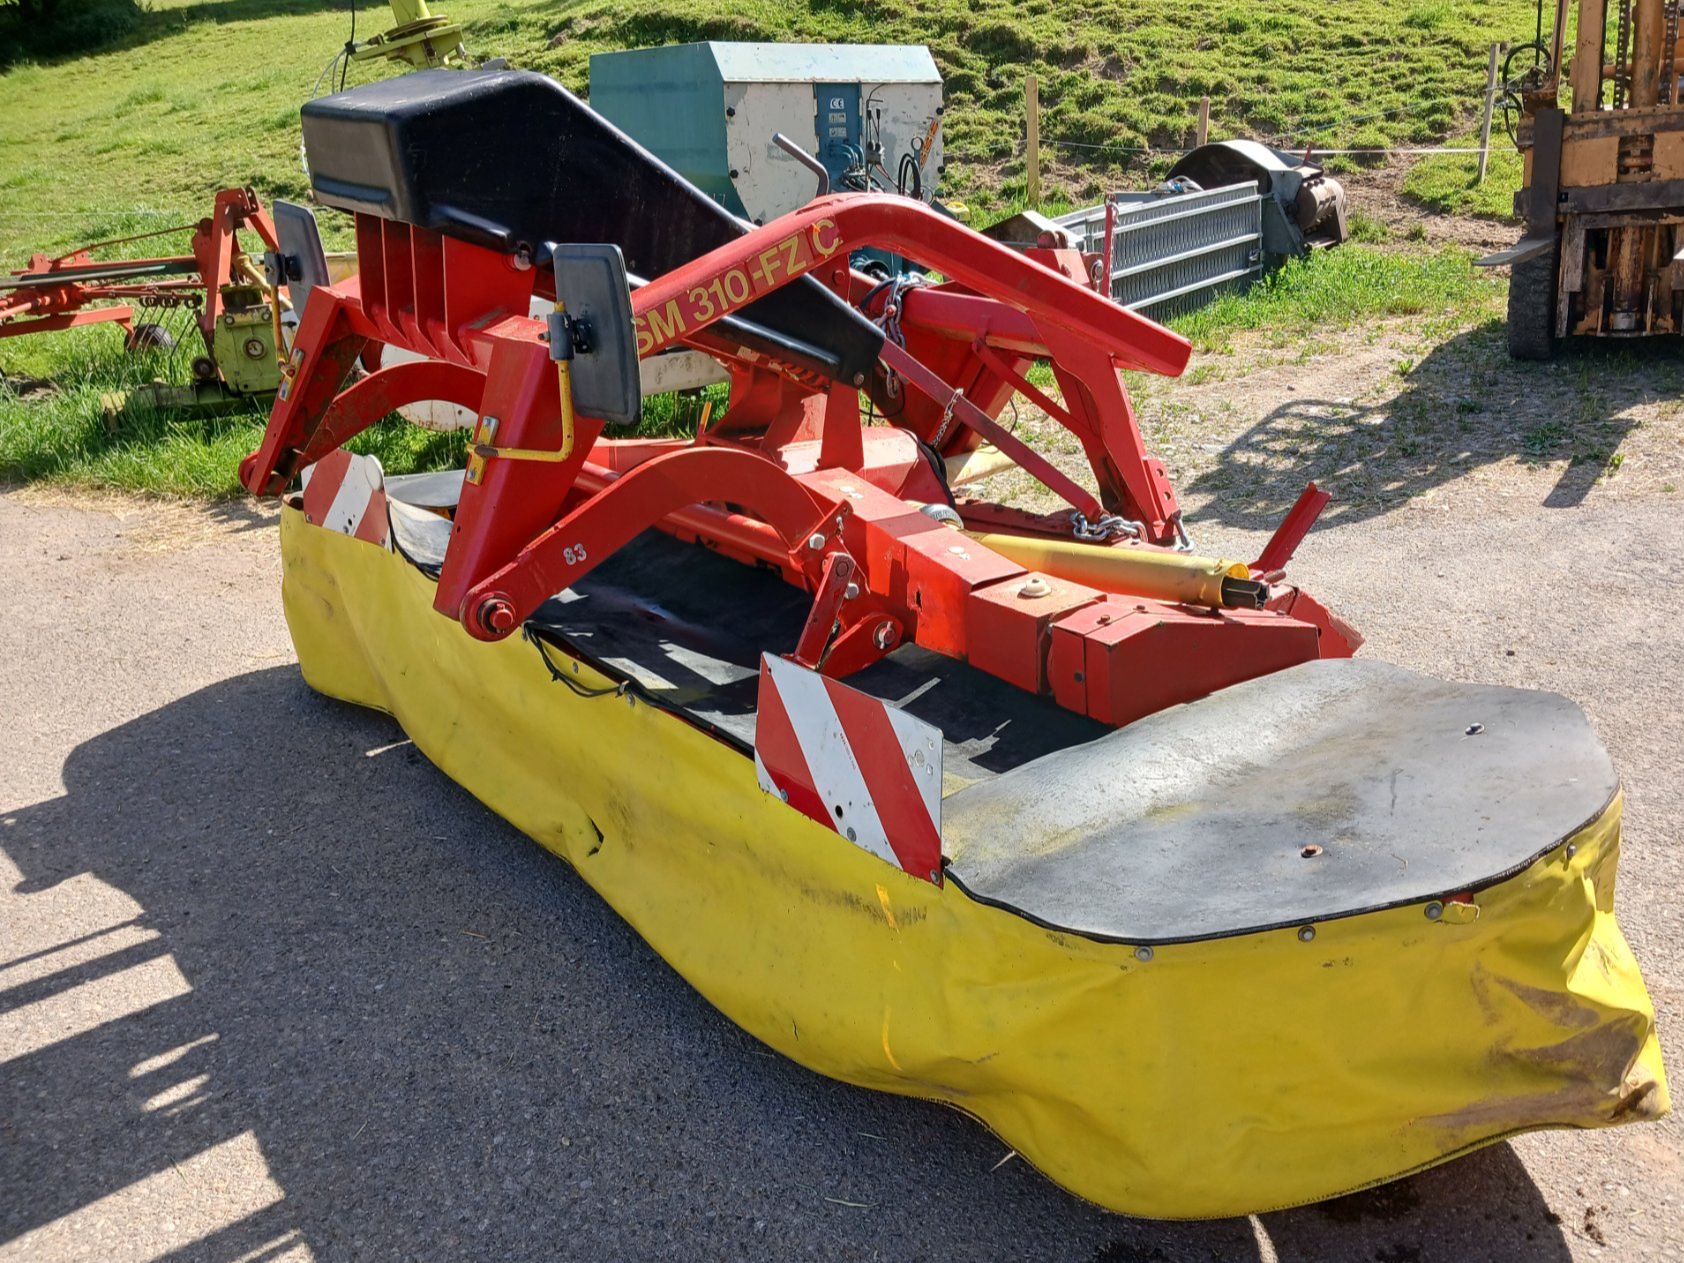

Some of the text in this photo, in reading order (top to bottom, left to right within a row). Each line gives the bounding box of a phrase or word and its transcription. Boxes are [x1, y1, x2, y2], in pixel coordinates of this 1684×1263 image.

[635, 299, 686, 354] SM
[688, 234, 807, 322] 310-FZ
[563, 543, 587, 566] 83
